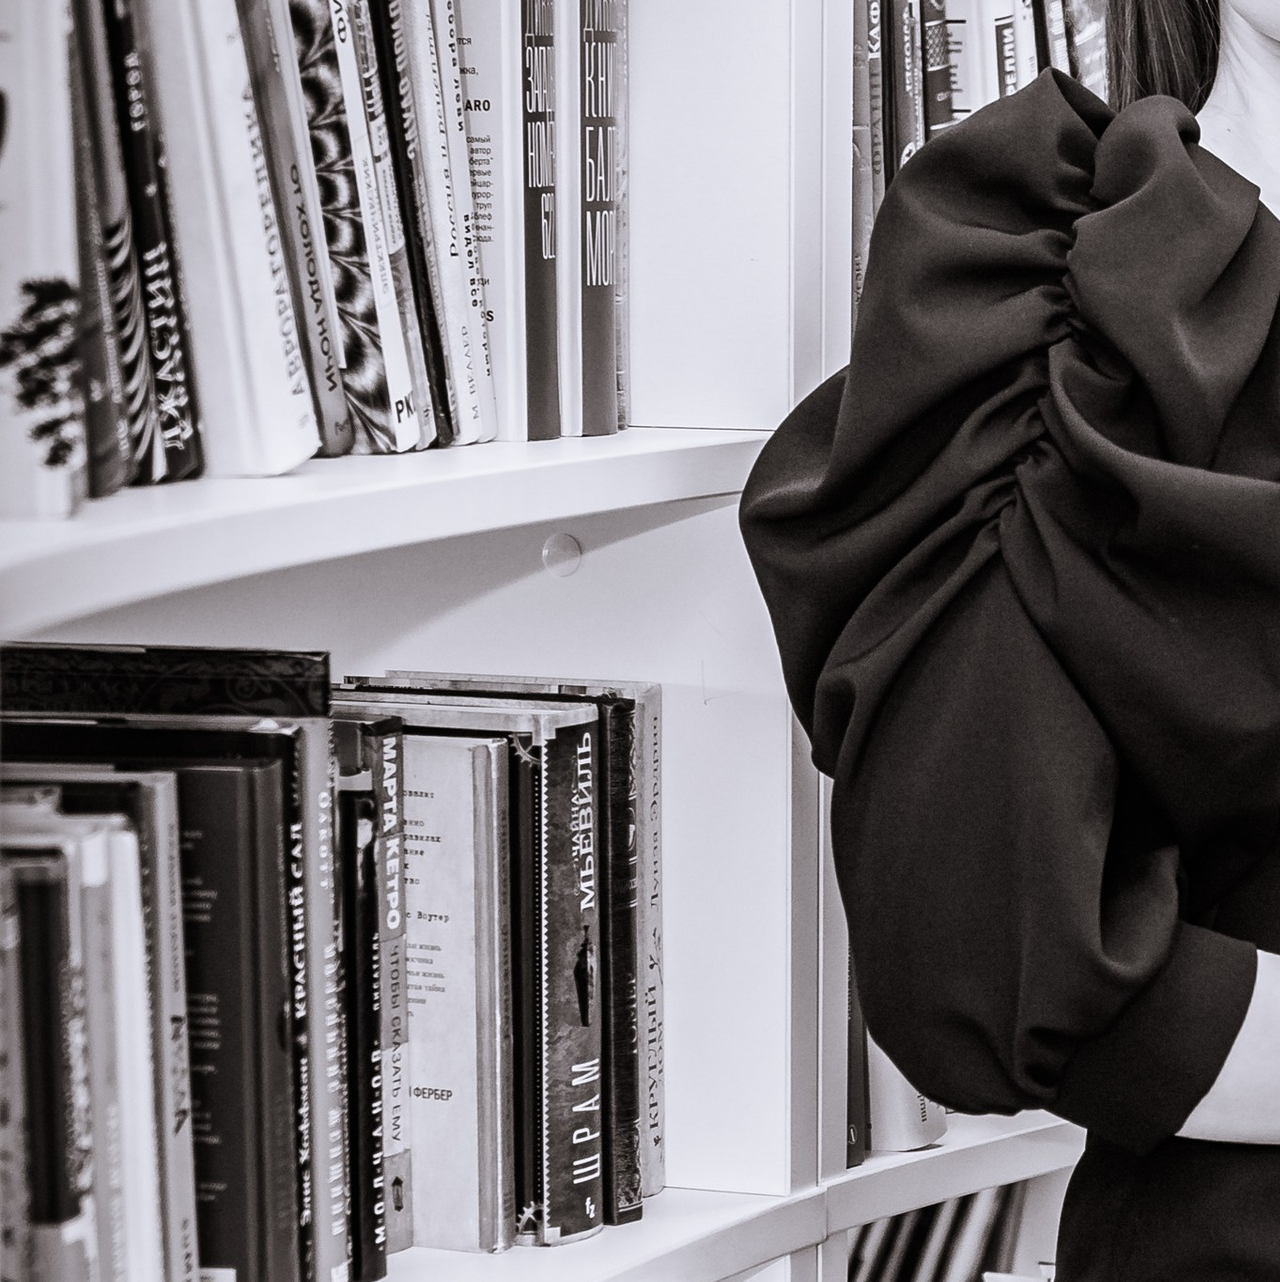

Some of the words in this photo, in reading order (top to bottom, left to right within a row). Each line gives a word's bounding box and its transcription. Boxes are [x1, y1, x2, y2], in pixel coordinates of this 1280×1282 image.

[399, 77, 418, 160] ЗАХАР
[441, 139, 448, 157] и
[869, 71, 882, 176] ФРАНЦ
[442, 167, 459, 257] Россия
[464, 214, 474, 269] видел
[290, 165, 304, 193] ОТ
[297, 201, 323, 313] ХОЛОДА
[317, 319, 338, 393] НОЧИ
[382, 736, 397, 833] МАРТА
[570, 794, 580, 856] ЧАЙНА
[577, 732, 596, 913] МЬЕВИЛЬ
[386, 837, 401, 930] КЕТРО
[288, 885, 308, 1019] КРАСНЫЙ
[390, 945, 400, 1009] ЧТОБЫ
[391, 1016, 402, 1098] СКАЗАТЬ
[413, 1086, 453, 1102] ФЕРБЕР
[645, 985, 658, 1129] КРУГЛЫЙ
[392, 1105, 402, 1142] ЕМУ
[571, 1058, 601, 1184] ШРАМ
